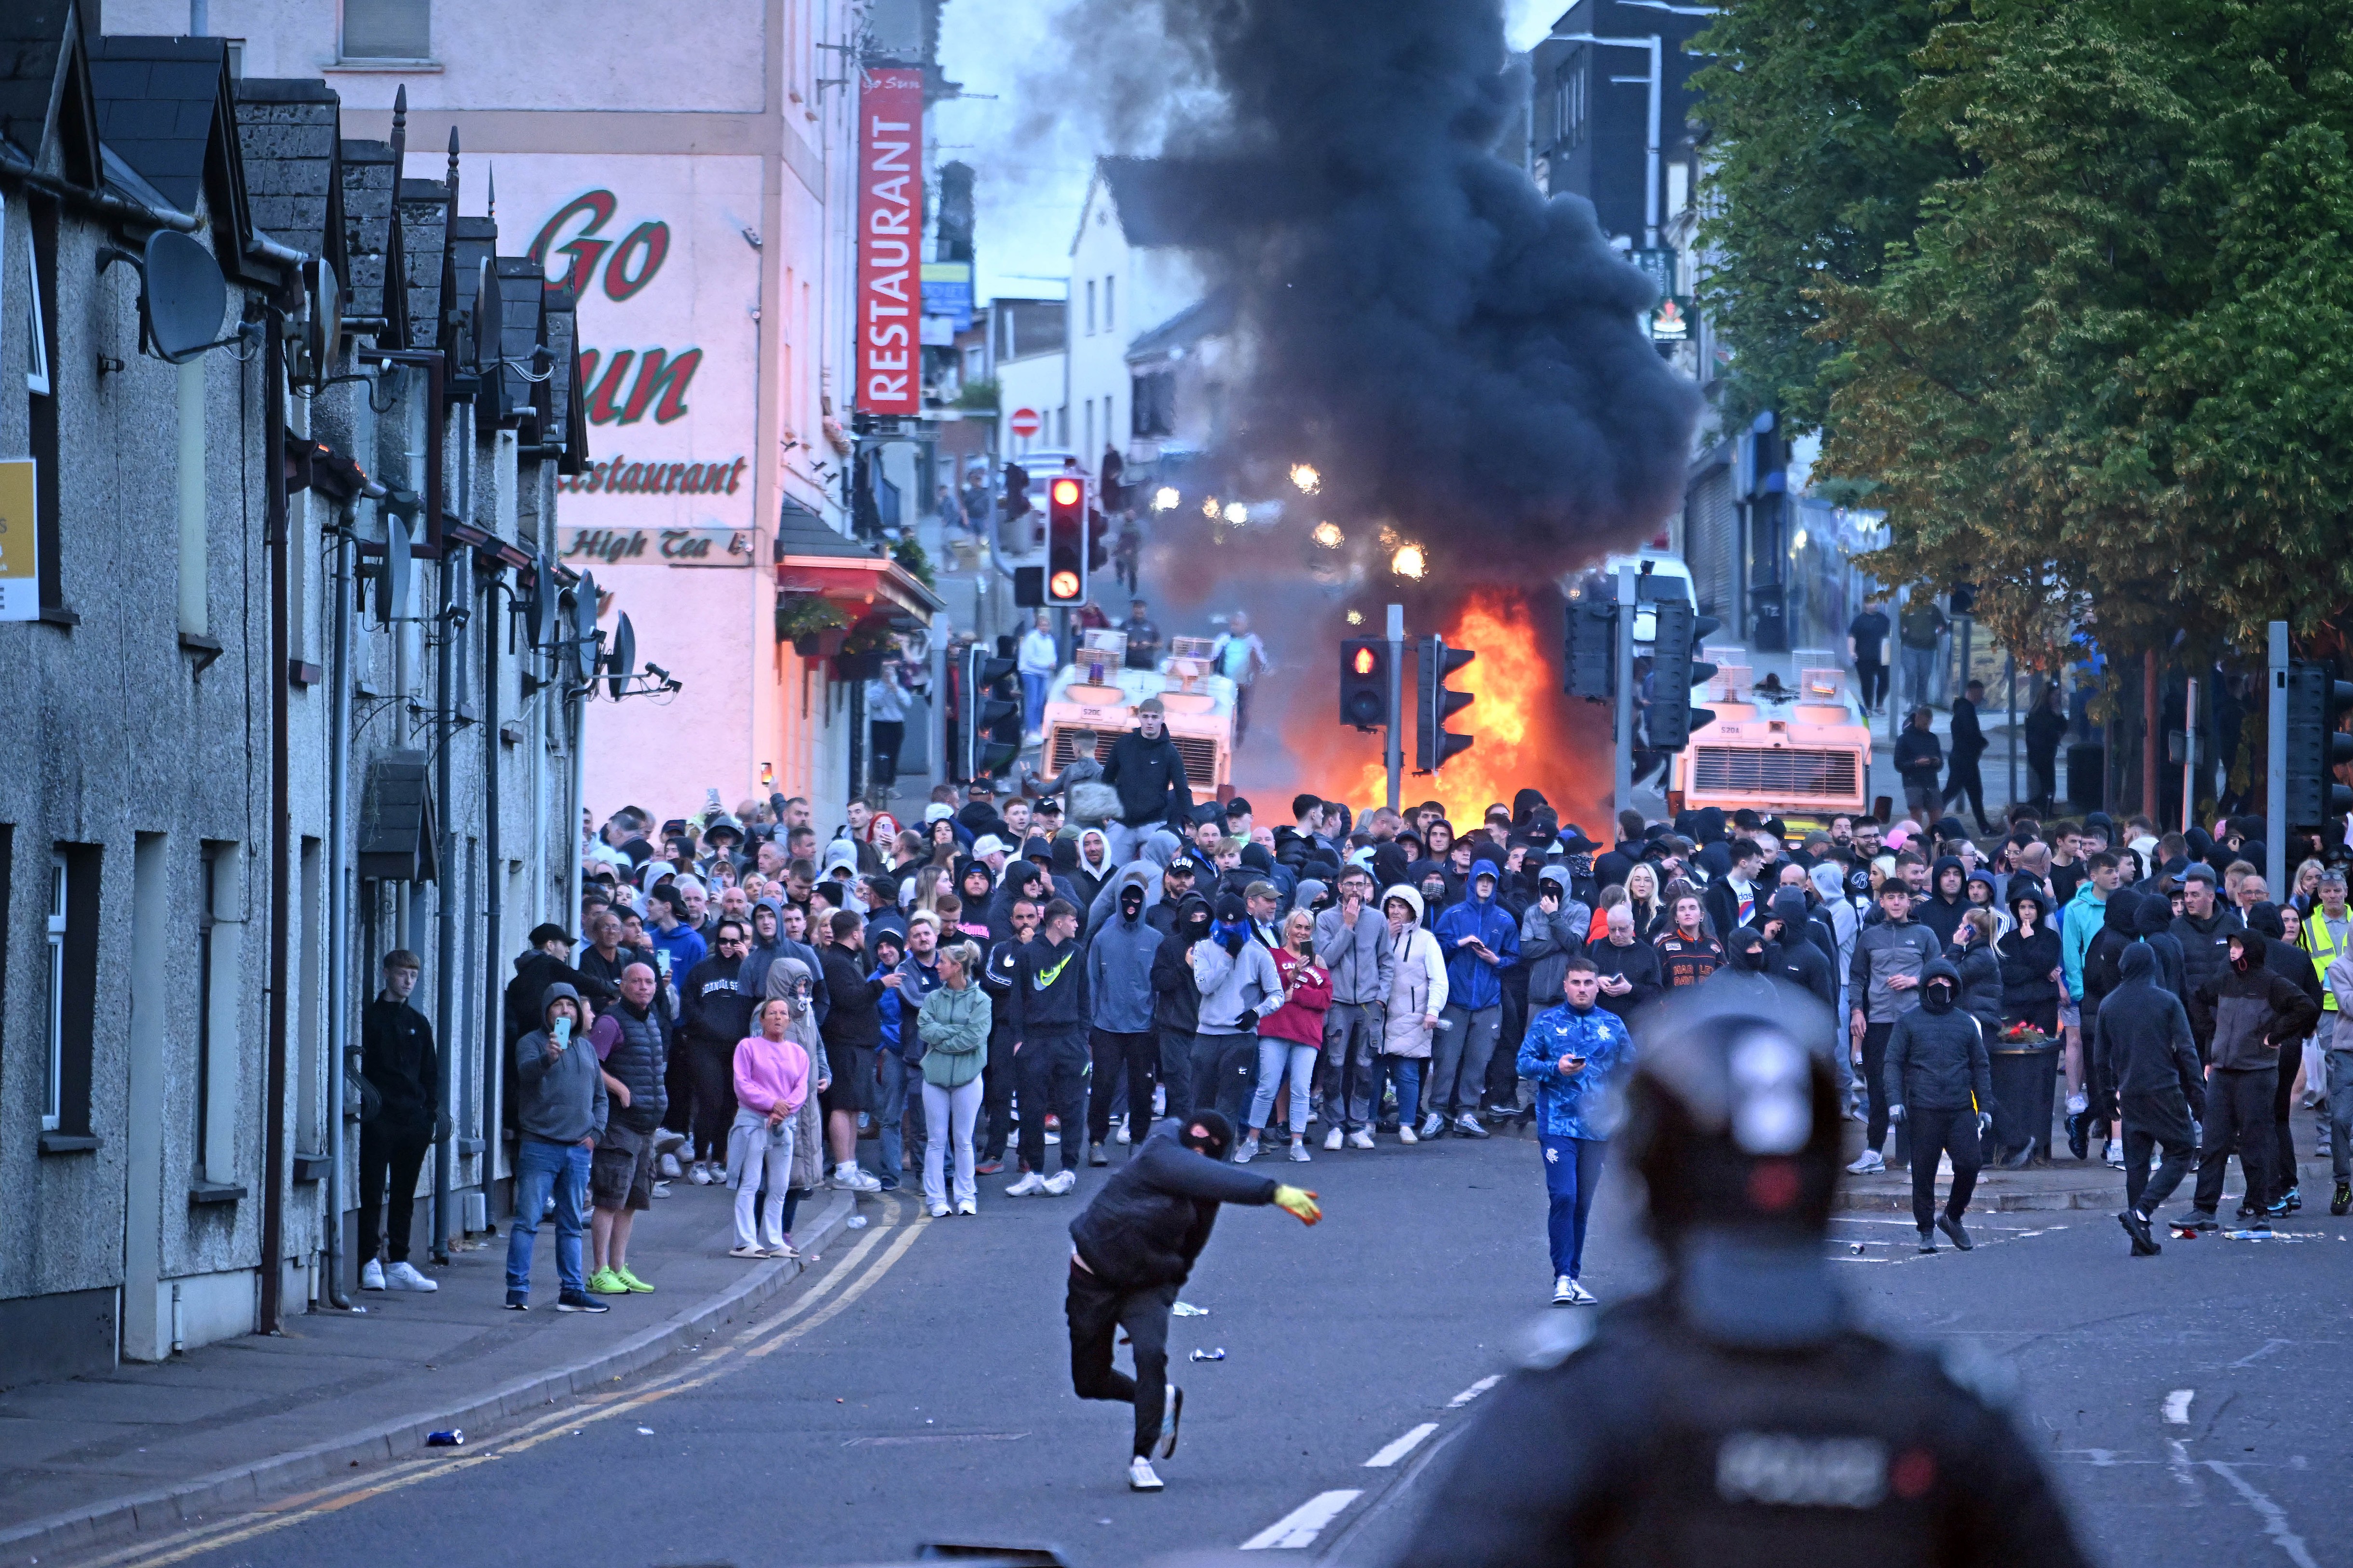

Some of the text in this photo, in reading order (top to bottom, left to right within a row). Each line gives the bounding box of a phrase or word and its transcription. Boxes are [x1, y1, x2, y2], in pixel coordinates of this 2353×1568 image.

[526, 189, 671, 302] Go
[869, 116, 911, 401] RESTAURANT
[579, 348, 703, 426] un
[562, 529, 648, 563] High
[659, 529, 712, 558] Tea
[1172, 857, 1193, 868] ICON
[1738, 892, 1754, 901] das
